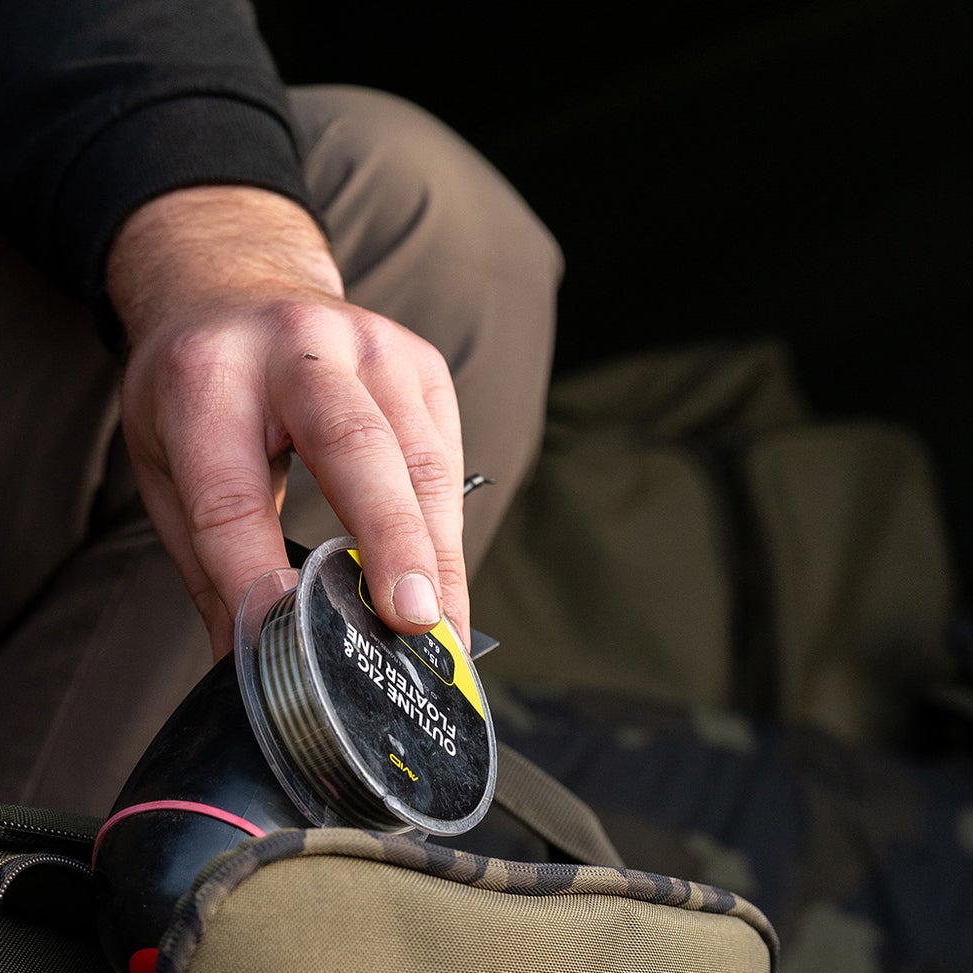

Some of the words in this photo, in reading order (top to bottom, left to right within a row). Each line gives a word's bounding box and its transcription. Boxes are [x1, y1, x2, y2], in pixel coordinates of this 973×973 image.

[343, 638, 354, 658] &
[346, 623, 382, 669] LINE
[357, 653, 385, 690] ZIG
[385, 662, 456, 740] FLOATER
[387, 682, 456, 757] OUTLINE
[389, 753, 419, 782] AVID
